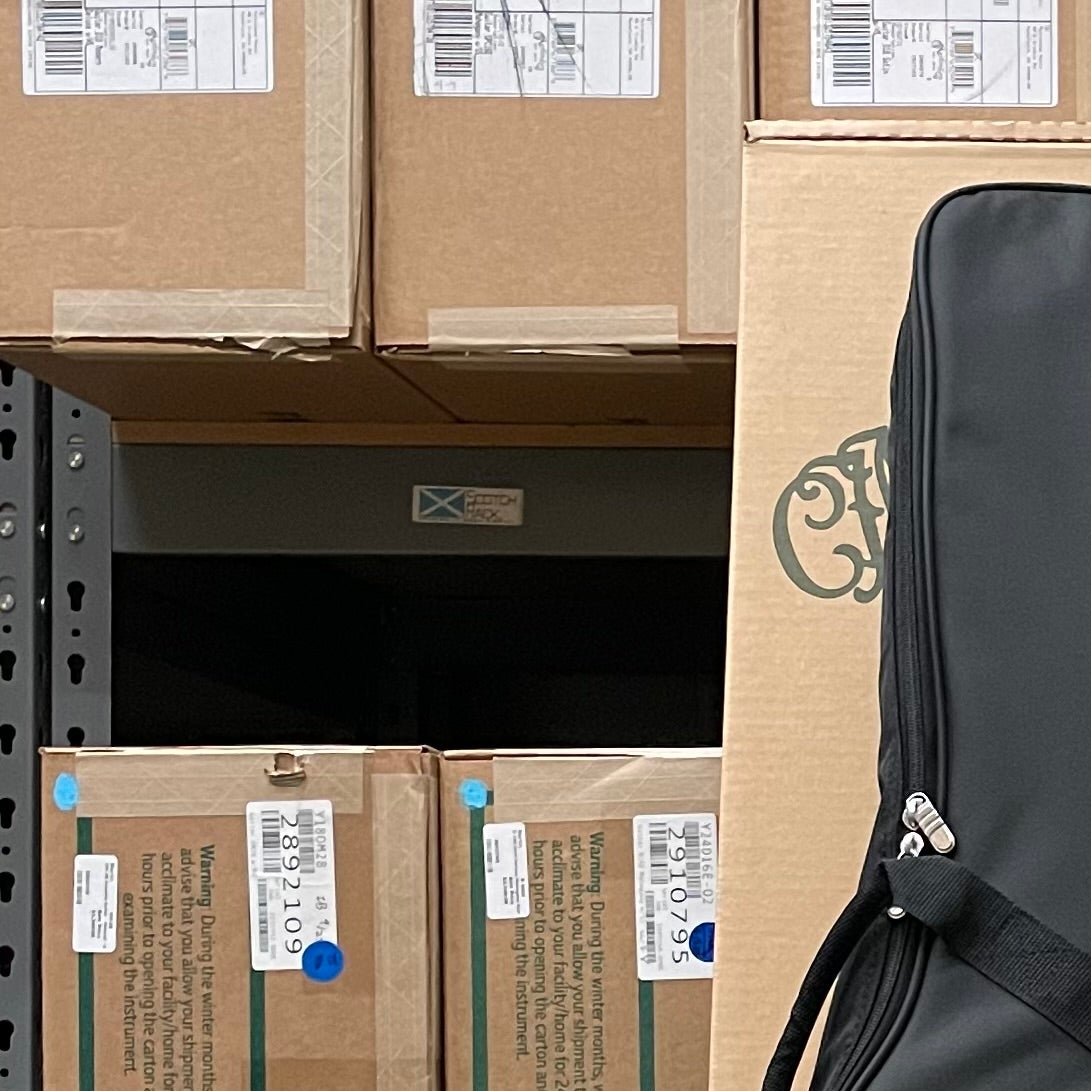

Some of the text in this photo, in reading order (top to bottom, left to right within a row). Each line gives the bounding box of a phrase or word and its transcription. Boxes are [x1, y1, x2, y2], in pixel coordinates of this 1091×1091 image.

[142, 853, 157, 892] hours
[180, 848, 196, 893] advise
[532, 840, 547, 879] hours
[552, 840, 566, 905] acclimate
[570, 835, 585, 880] advise
[162, 852, 176, 918] acclimate
[281, 814, 302, 954] 2892109
[531, 883, 547, 916] prior
[571, 883, 585, 910] that
[668, 827, 689, 964] 2910795
[120, 893, 137, 964] examining
[139, 897, 157, 929] prior
[182, 897, 196, 924] that
[534, 920, 546, 932] to
[553, 909, 566, 921] to
[568, 915, 583, 940] you
[588, 902, 605, 947] During
[142, 934, 155, 947] to
[162, 923, 175, 937] to
[177, 930, 192, 954] you
[199, 915, 215, 962] During
[550, 926, 564, 956] your
[158, 941, 173, 971] your
[515, 955, 530, 977] the
[532, 938, 547, 992] opening
[572, 944, 586, 980] allow
[591, 951, 606, 973] the
[123, 970, 137, 991] the
[139, 952, 157, 1009] opening
[182, 959, 196, 995] allow
[202, 966, 215, 989] the
[178, 1000, 194, 1030] your
[202, 992, 215, 1036] winter
[535, 997, 549, 1019] the
[550, 961, 569, 1052] facility/home
[568, 984, 583, 1015] your
[591, 978, 605, 1021] winter
[143, 1012, 157, 1035] the
[159, 976, 178, 1068] facility/home
[516, 981, 530, 1060] instrument.
[143, 1039, 156, 1084] carton
[536, 1024, 549, 1068] carton
[571, 1019, 588, 1083] shipment
[590, 1026, 606, 1080] months,
[164, 1073, 178, 1091] for
[555, 1057, 569, 1076] for
